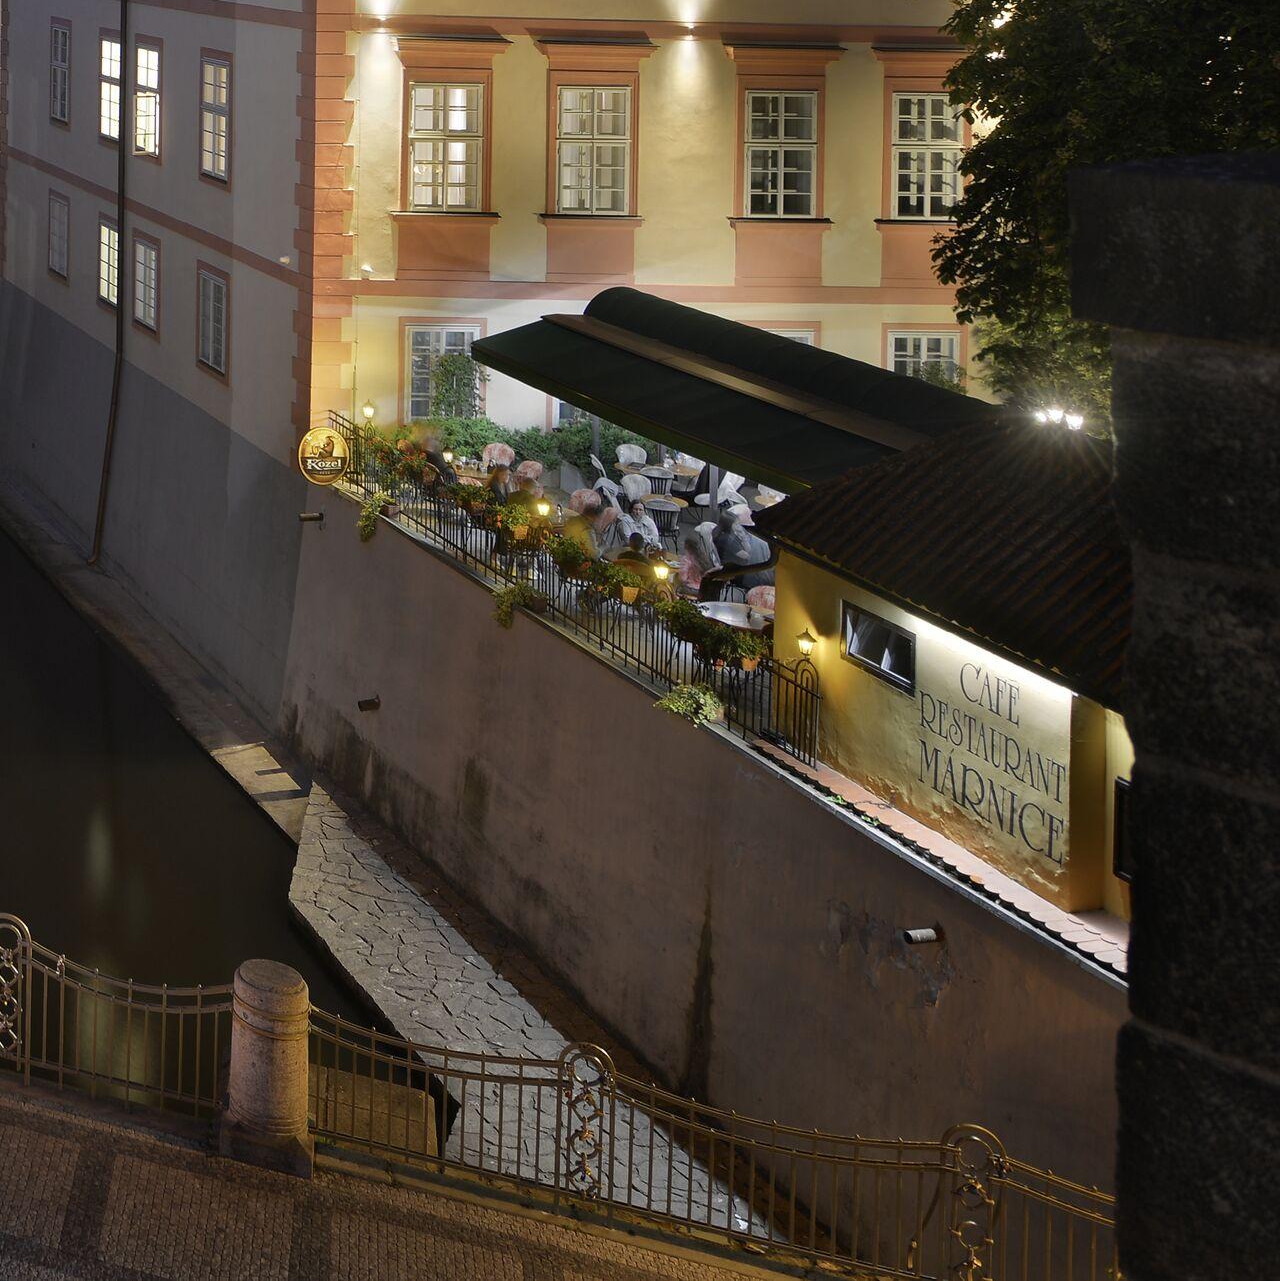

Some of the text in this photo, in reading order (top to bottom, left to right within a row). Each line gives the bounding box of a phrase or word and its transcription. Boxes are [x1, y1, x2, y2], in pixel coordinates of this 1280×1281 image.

[306, 458, 342, 470] Kozel
[918, 689, 1066, 804] RESTAURANT
[918, 738, 1064, 865] MÁRNICE
